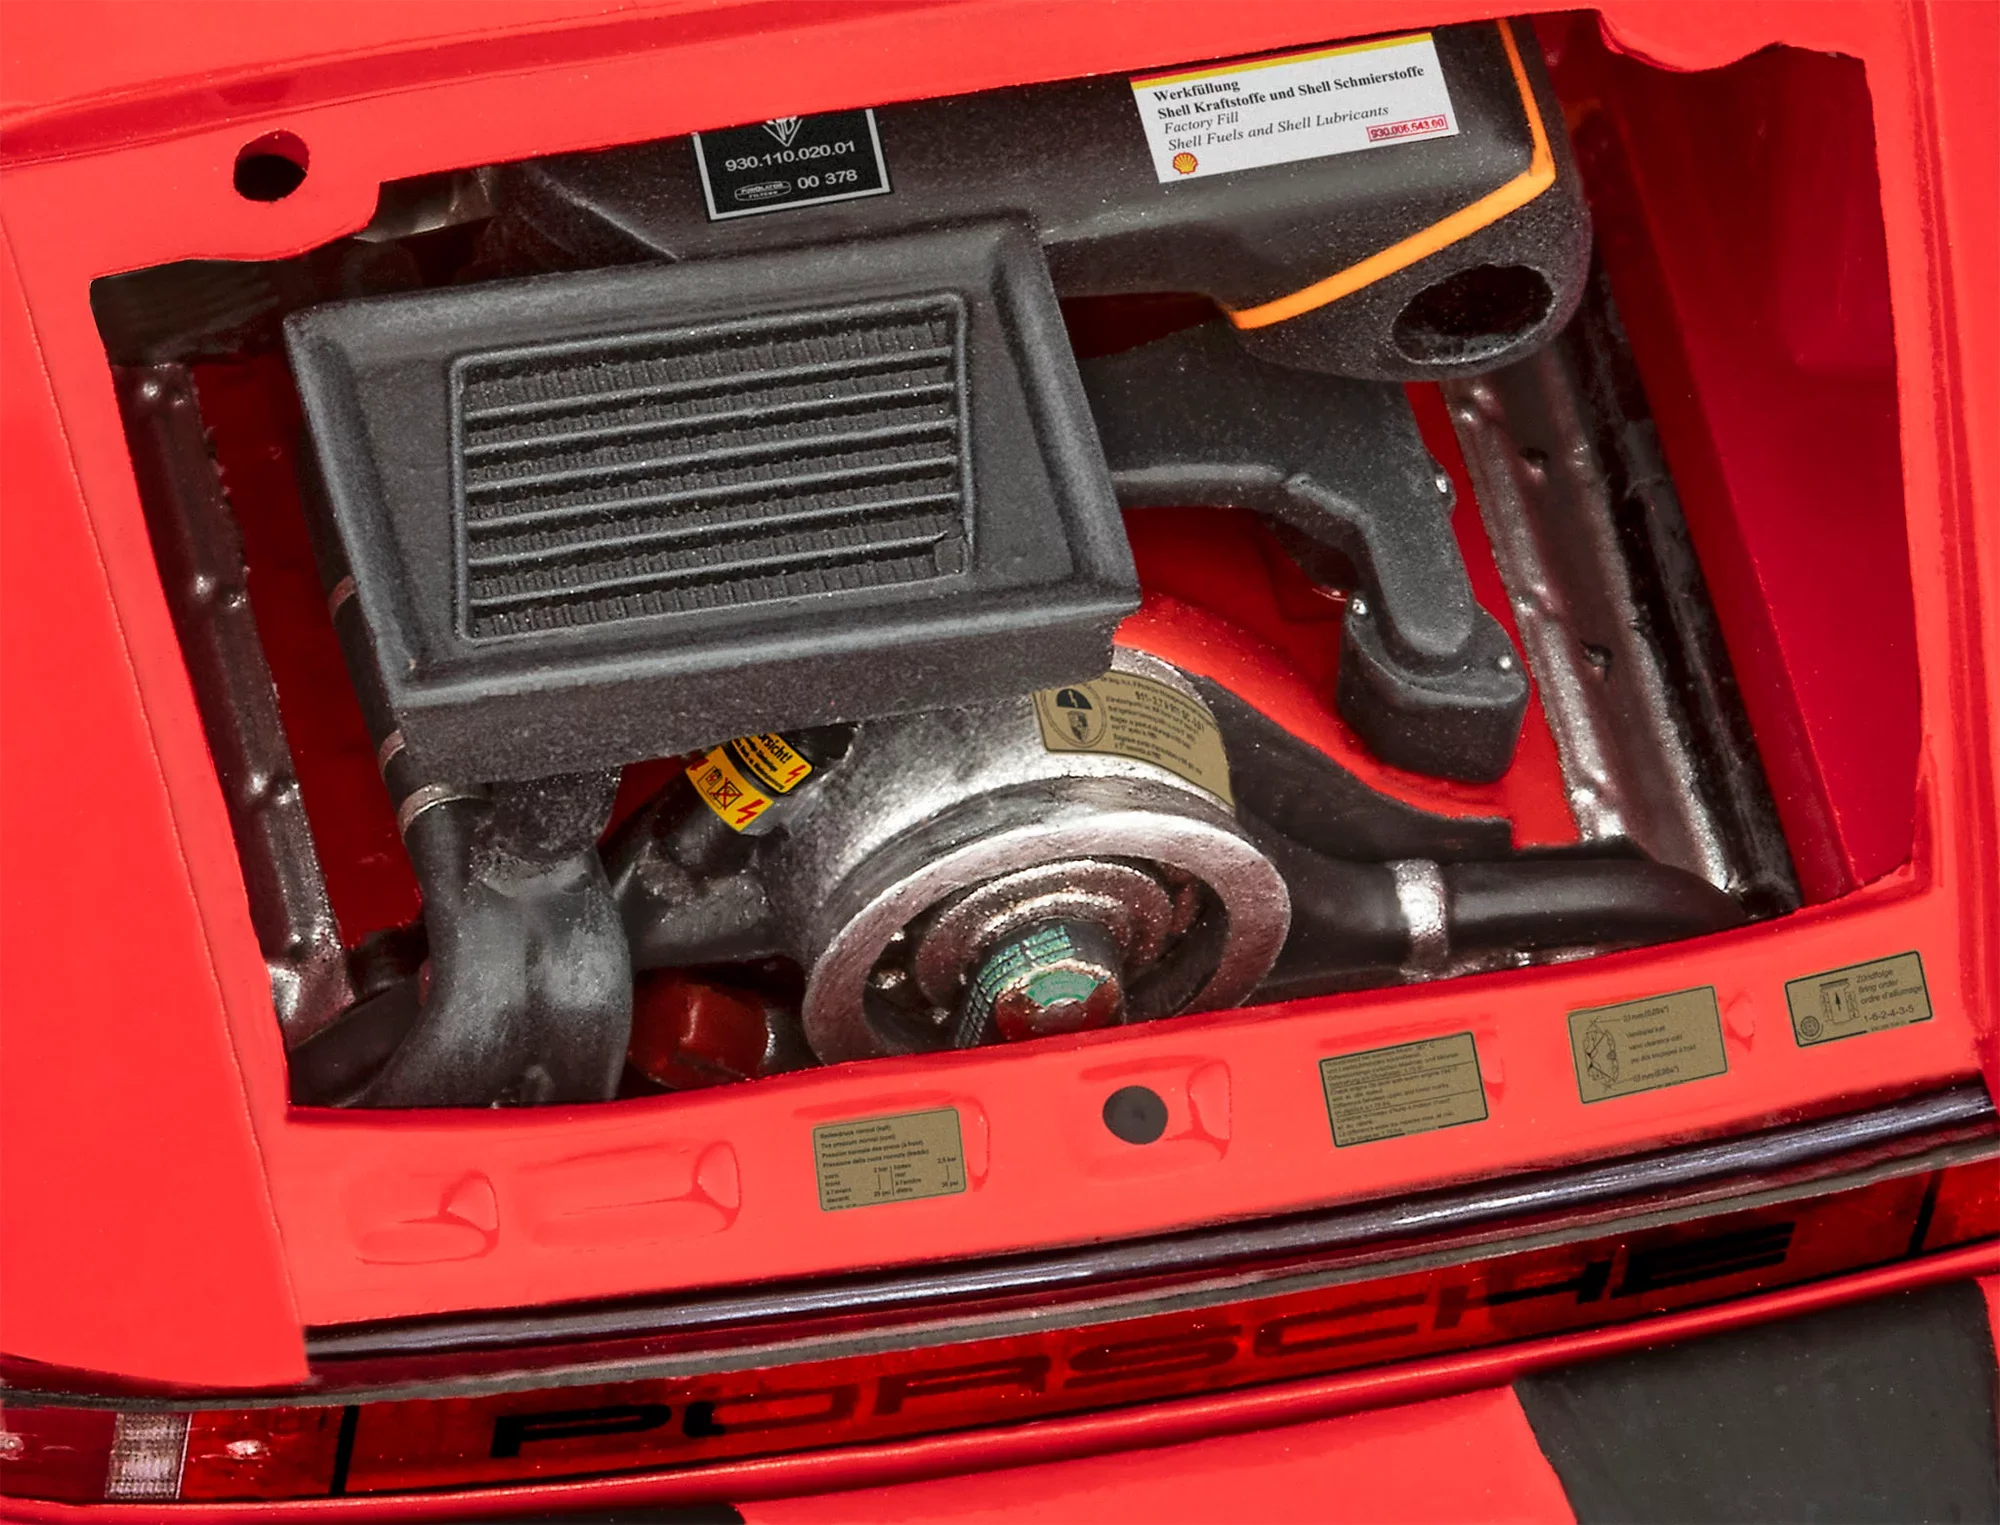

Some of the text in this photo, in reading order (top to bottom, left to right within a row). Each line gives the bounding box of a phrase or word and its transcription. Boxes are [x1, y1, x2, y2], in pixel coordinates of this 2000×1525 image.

[1153, 81, 1240, 102] Werkfüllung
[1157, 65, 1425, 120] Shell Kraftstoffe und Shell Schmierstoffe
[1164, 111, 1239, 134] Factory Fill
[1168, 106, 1389, 151] Shell Fuels and Shell Lubricants
[725, 140, 855, 172] 930.110.020.01
[797, 169, 858, 189] 00 378
[489, 1220, 1797, 1459] PORSCHE
